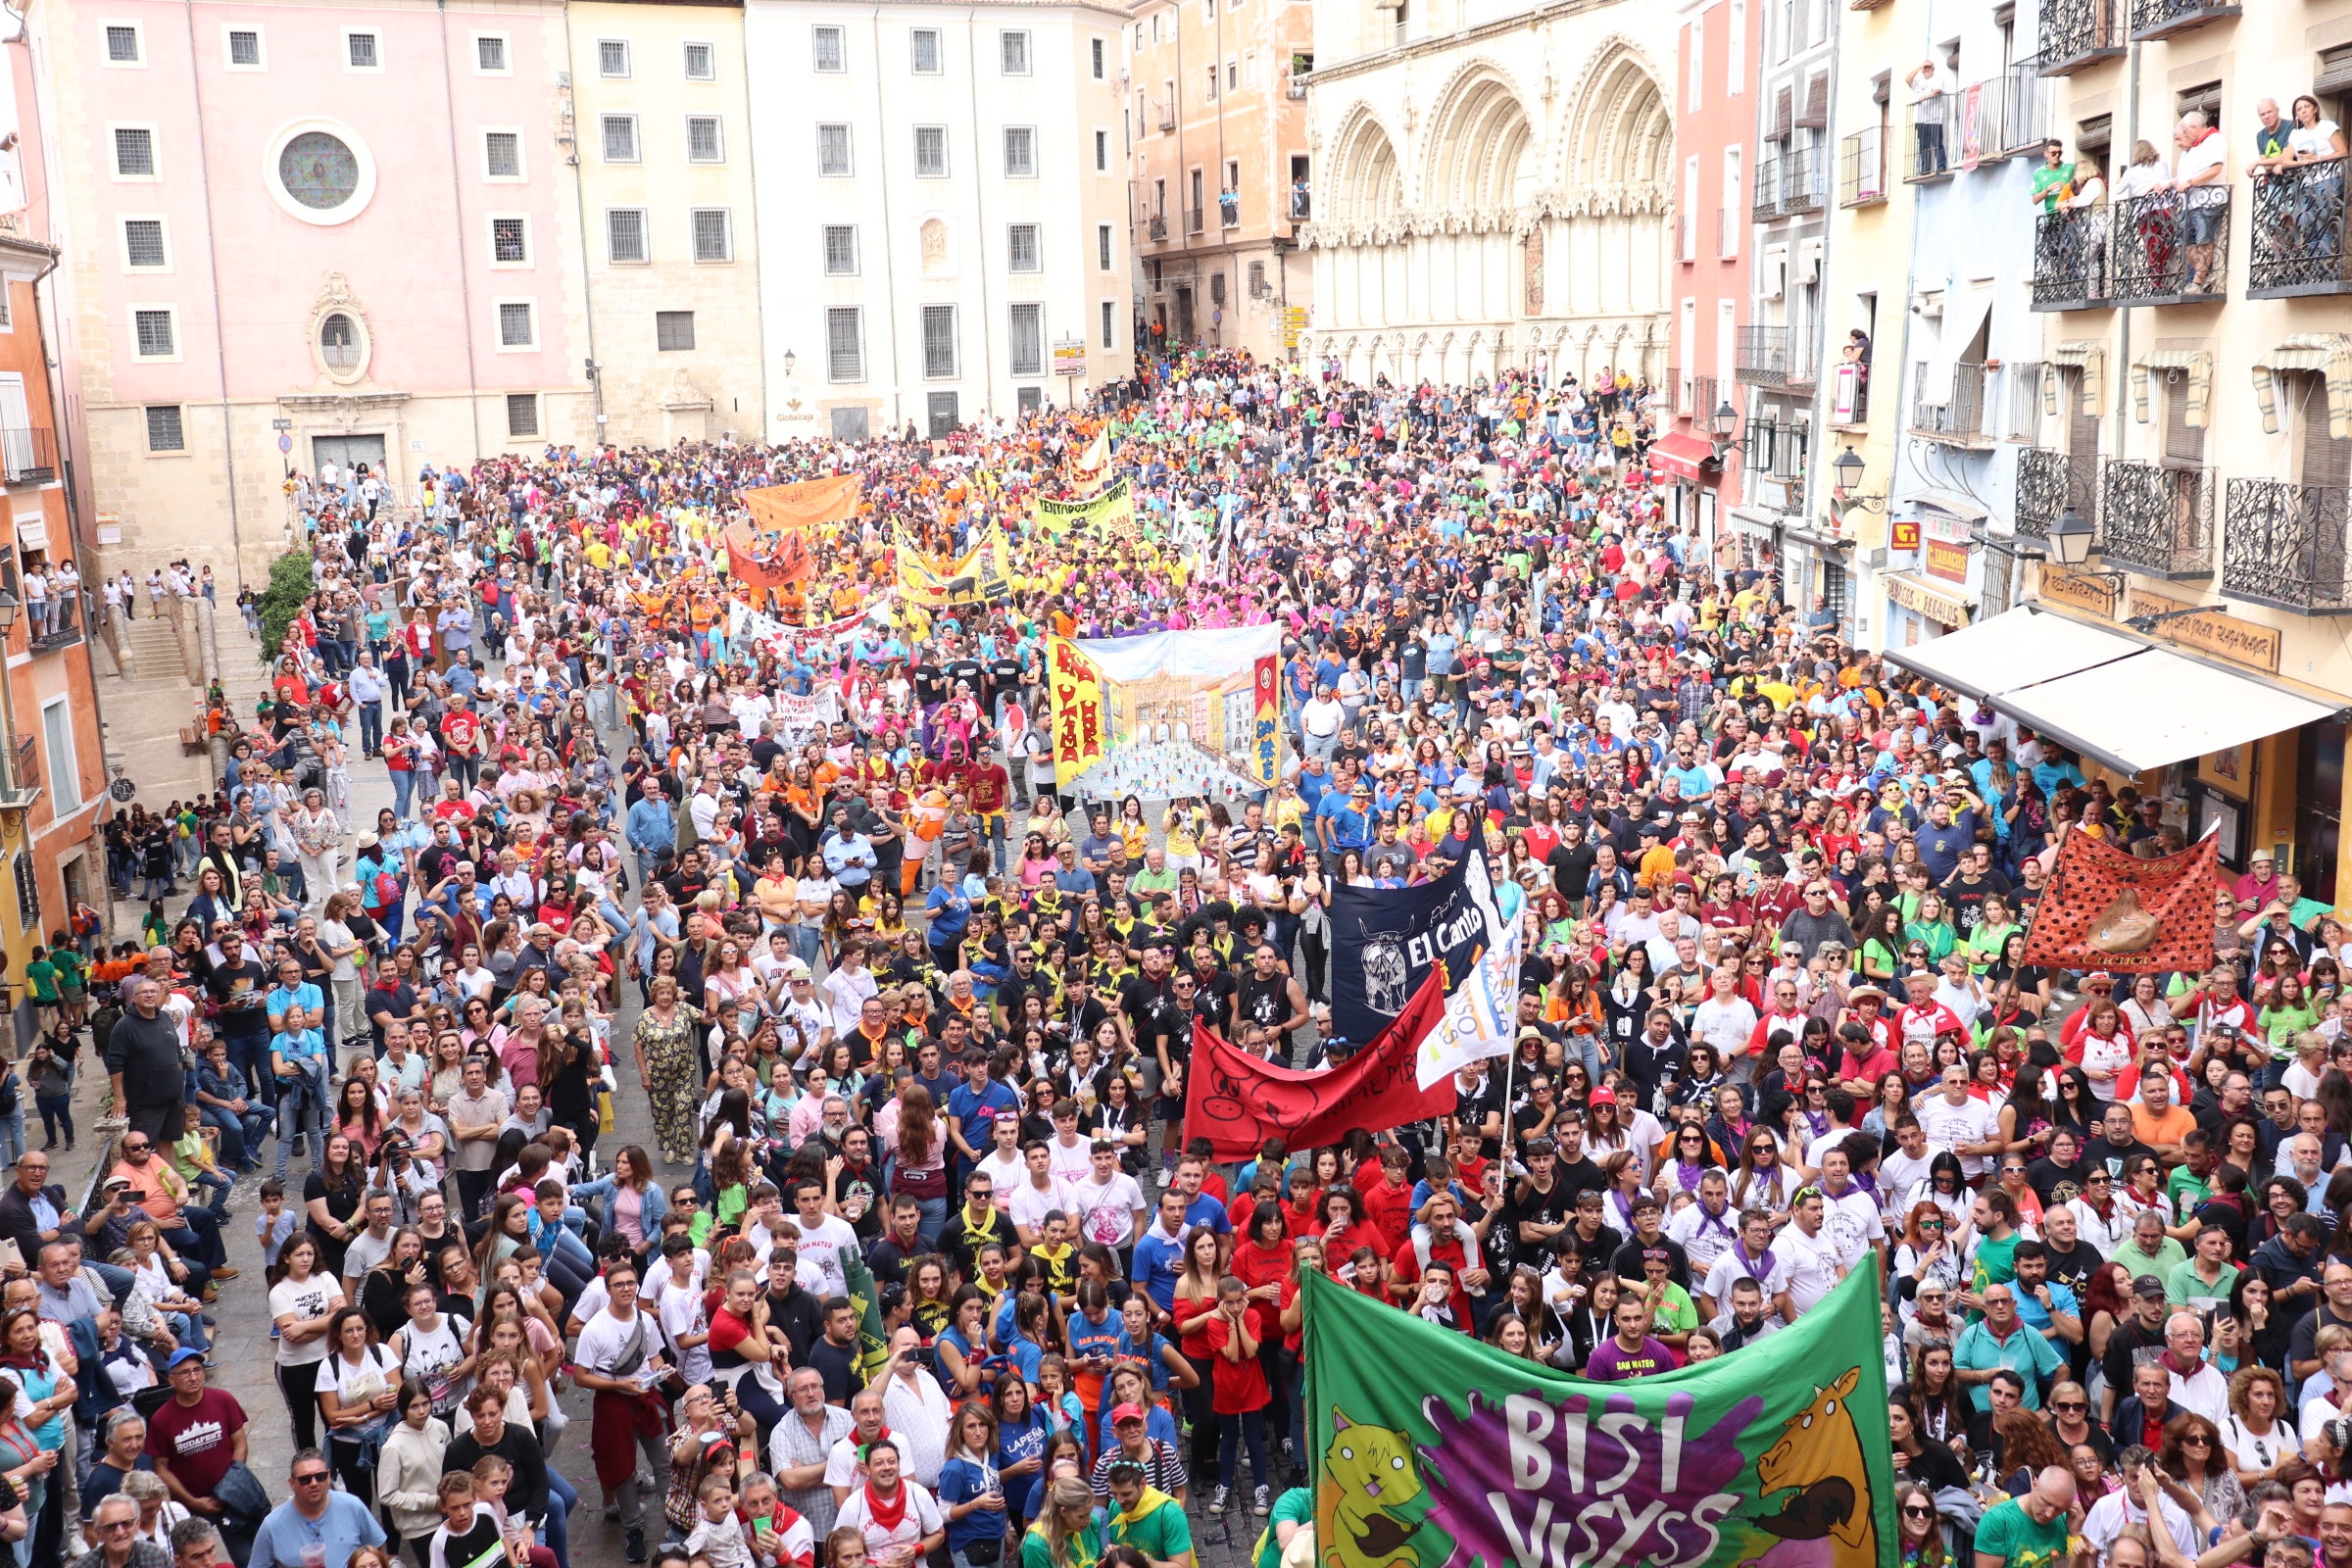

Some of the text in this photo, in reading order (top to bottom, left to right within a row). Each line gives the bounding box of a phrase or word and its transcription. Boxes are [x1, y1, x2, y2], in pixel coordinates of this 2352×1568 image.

[777, 413, 814, 423] Globalcaja
[1109, 514, 1131, 529] SAN
[1935, 549, 1967, 570] TABACOS
[1887, 578, 1914, 606] TABACOS
[1407, 907, 1483, 968] El Canto
[2082, 952, 2151, 966] Cuenca
[798, 1240, 833, 1252] SAN MATEO
[295, 1291, 321, 1302] MICKEY
[298, 1298, 324, 1308] MOUSE
[1079, 1336, 1092, 1346] SAN
[1617, 1359, 1654, 1371] SAN MATEO
[176, 1429, 223, 1452] BUDAPEST
[1505, 1394, 1686, 1494] BISI
[183, 1443, 219, 1458] HUNGARY
